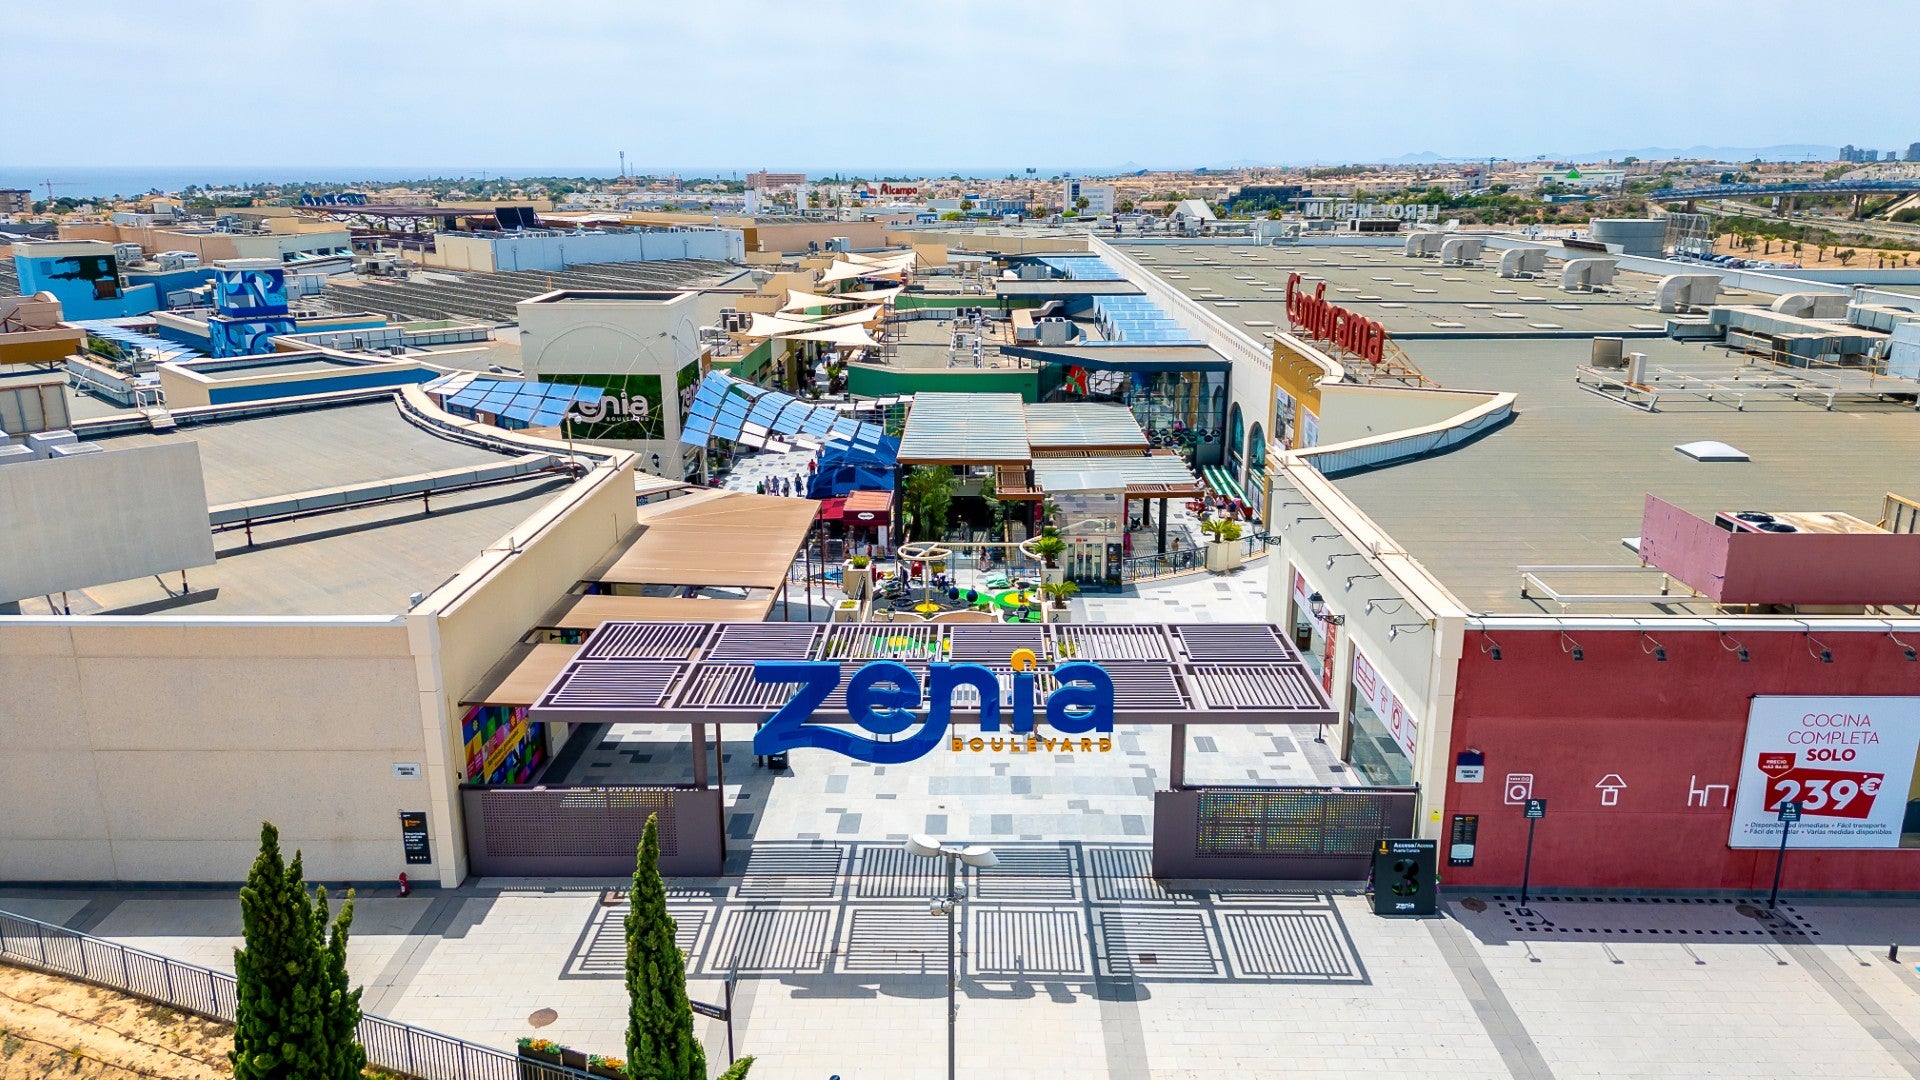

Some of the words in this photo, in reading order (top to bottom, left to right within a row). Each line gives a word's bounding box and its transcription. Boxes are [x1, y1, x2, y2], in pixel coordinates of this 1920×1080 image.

[880, 183, 918, 195] Alcampo
[1286, 272, 1384, 364] Conforama
[1802, 713, 1871, 728] COCINA
[951, 737, 1112, 752] BOULEVARD
[1787, 730, 1880, 745] COMPLETA
[1806, 748, 1856, 762] SOLO
[1836, 821, 1852, 829] Fácil
[1852, 822, 1887, 830] transporte
[1856, 828, 1893, 836] disponibles
[1392, 860, 1419, 896] 3
